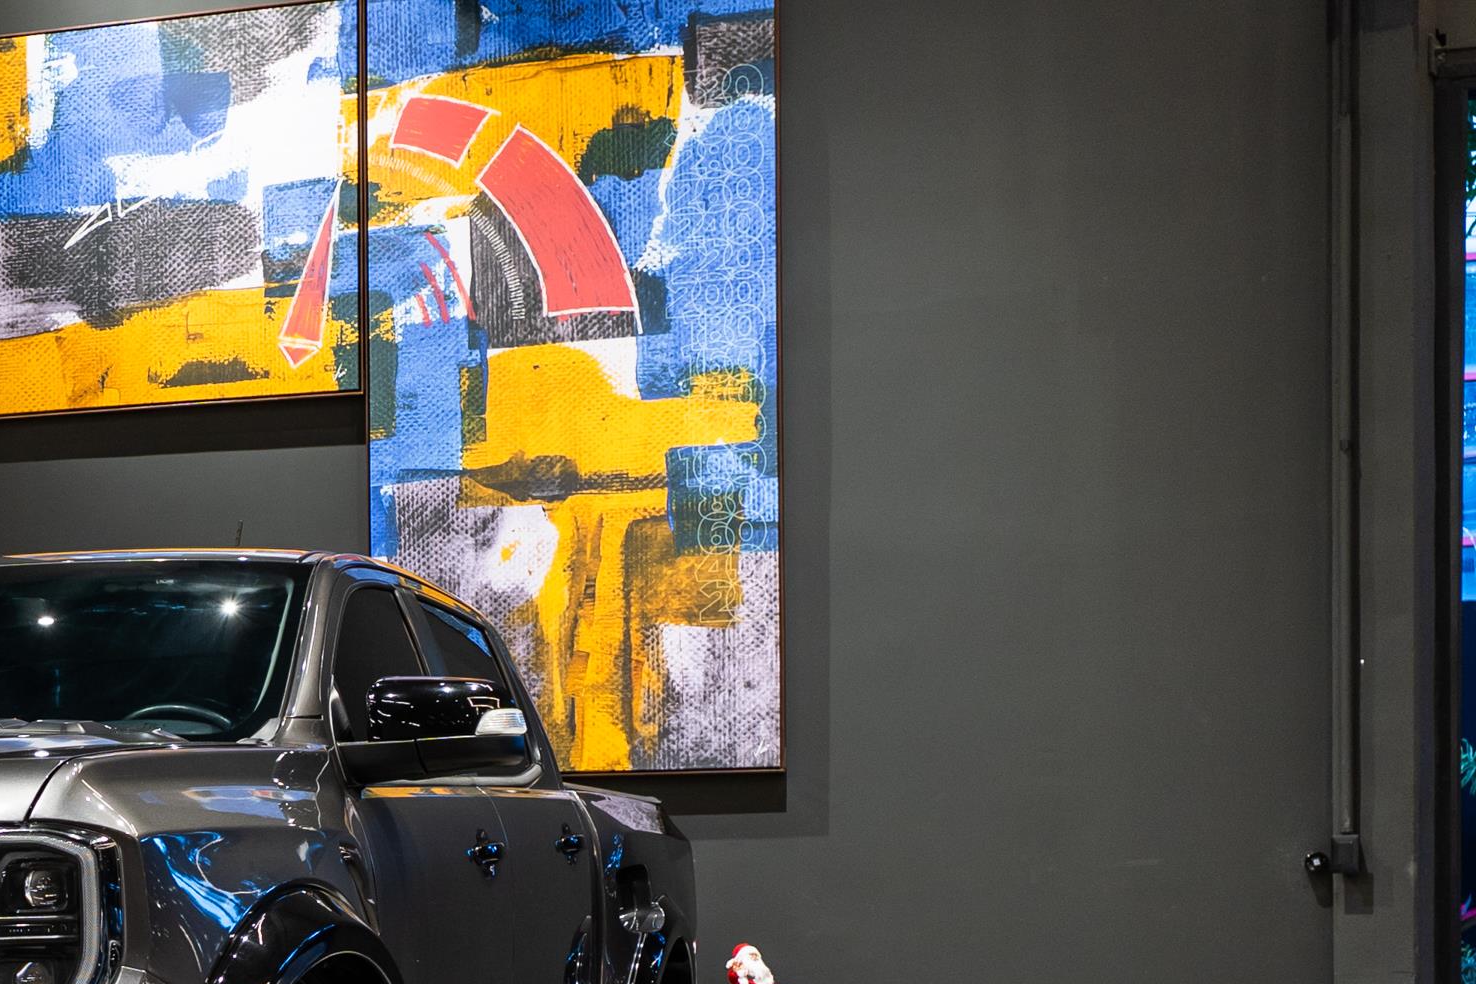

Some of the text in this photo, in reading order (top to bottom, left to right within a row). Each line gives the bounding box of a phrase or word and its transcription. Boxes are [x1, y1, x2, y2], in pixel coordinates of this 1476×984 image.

[665, 270, 765, 319] 200
[682, 304, 765, 352] 180
[678, 441, 766, 487] 100
[699, 475, 767, 520] 80
[698, 510, 767, 555] 60
